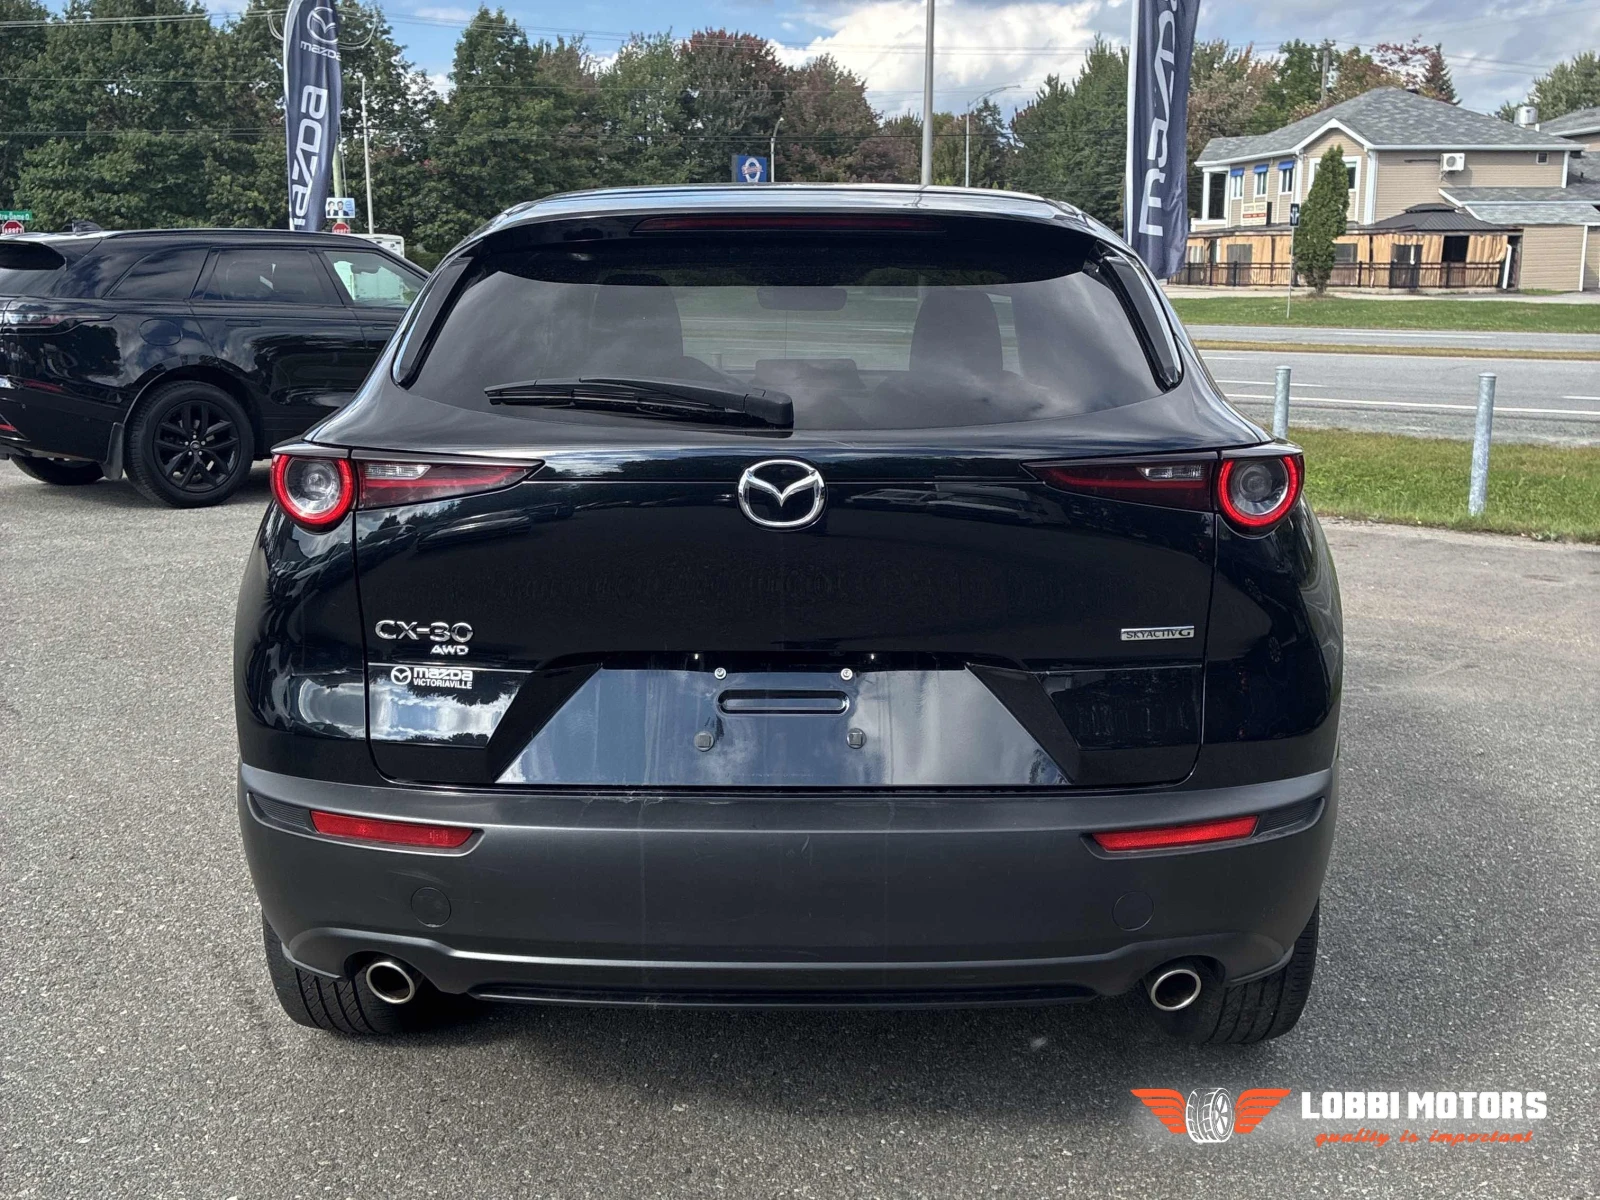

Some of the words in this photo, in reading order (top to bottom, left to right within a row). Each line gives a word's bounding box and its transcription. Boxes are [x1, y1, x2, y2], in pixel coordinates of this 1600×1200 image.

[375, 619, 474, 643] CX-30
[430, 644, 469, 656] AWD
[413, 667, 473, 681] mazda
[413, 678, 473, 690] VICTORIAVILLE
